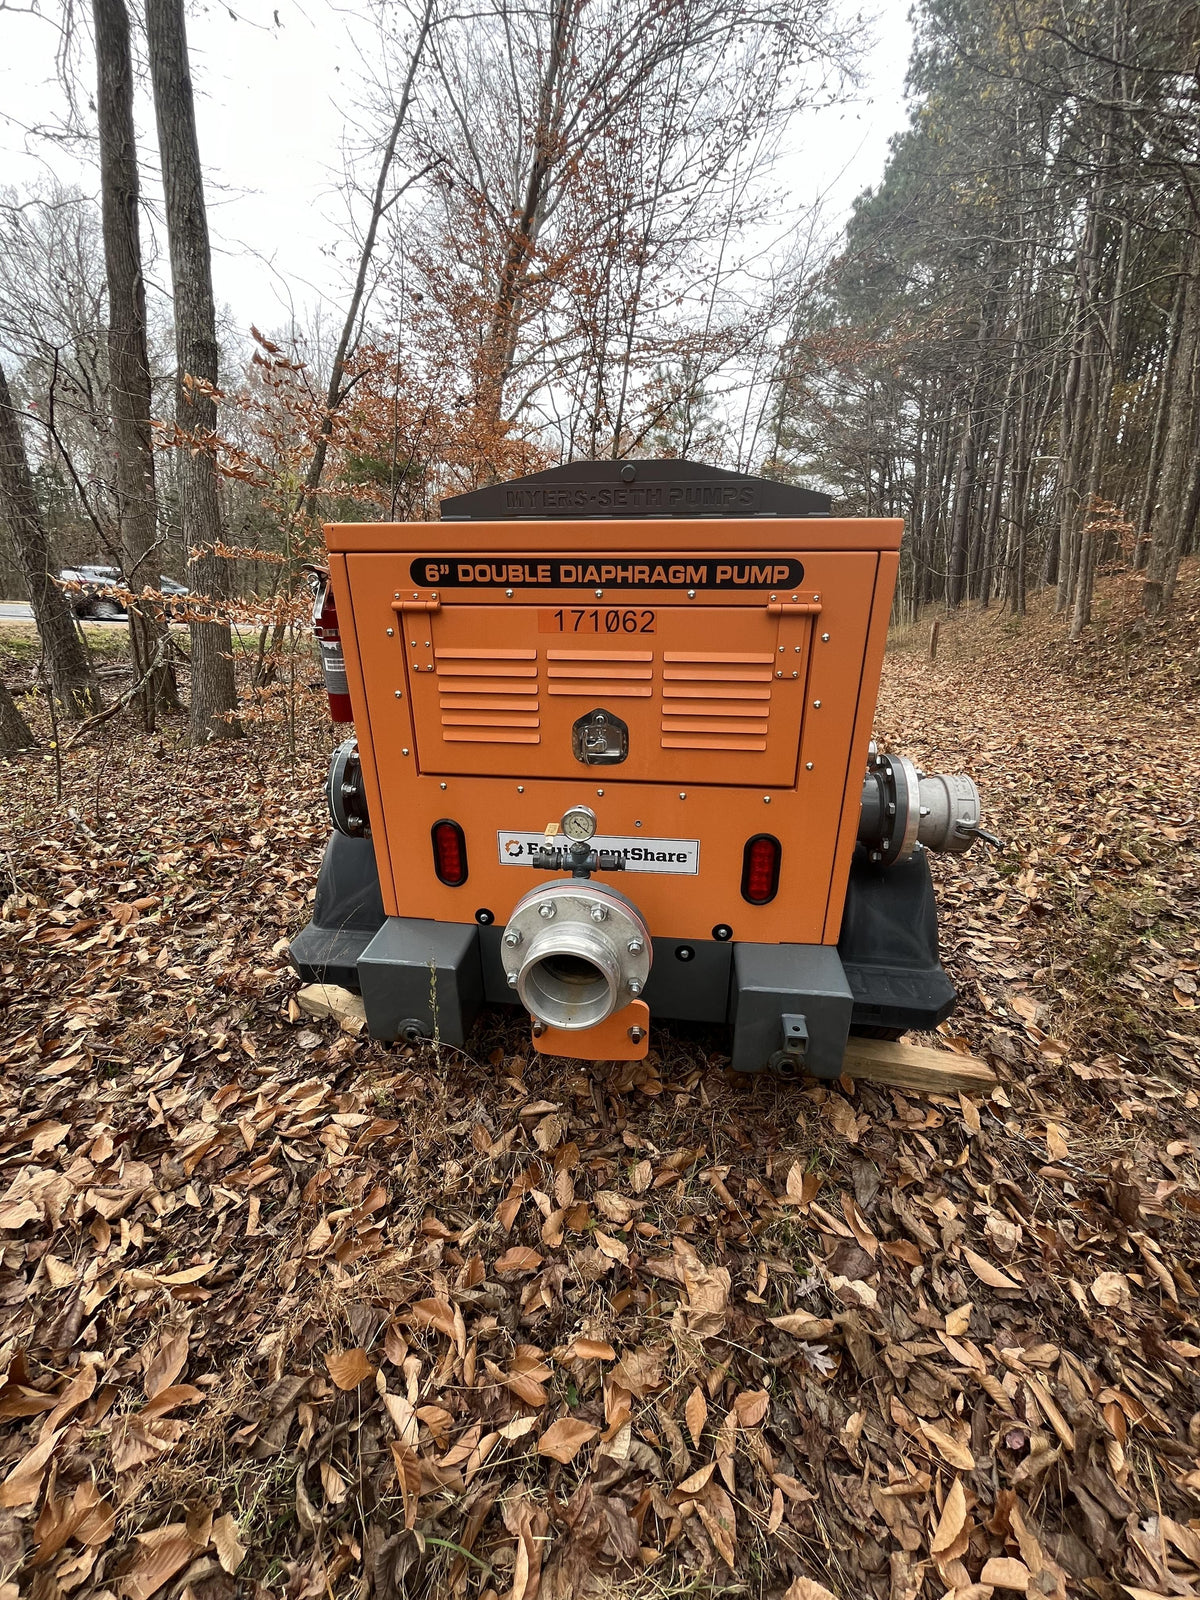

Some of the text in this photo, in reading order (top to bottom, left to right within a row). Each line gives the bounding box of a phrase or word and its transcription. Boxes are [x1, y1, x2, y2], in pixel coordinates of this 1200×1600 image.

[506, 486, 755, 509] MYERS-SETH PUMPS
[457, 564, 552, 583] DOUBLE
[559, 564, 707, 584] DIAPHRAGM
[715, 565, 790, 584] PUMP
[553, 609, 655, 633] 171062
